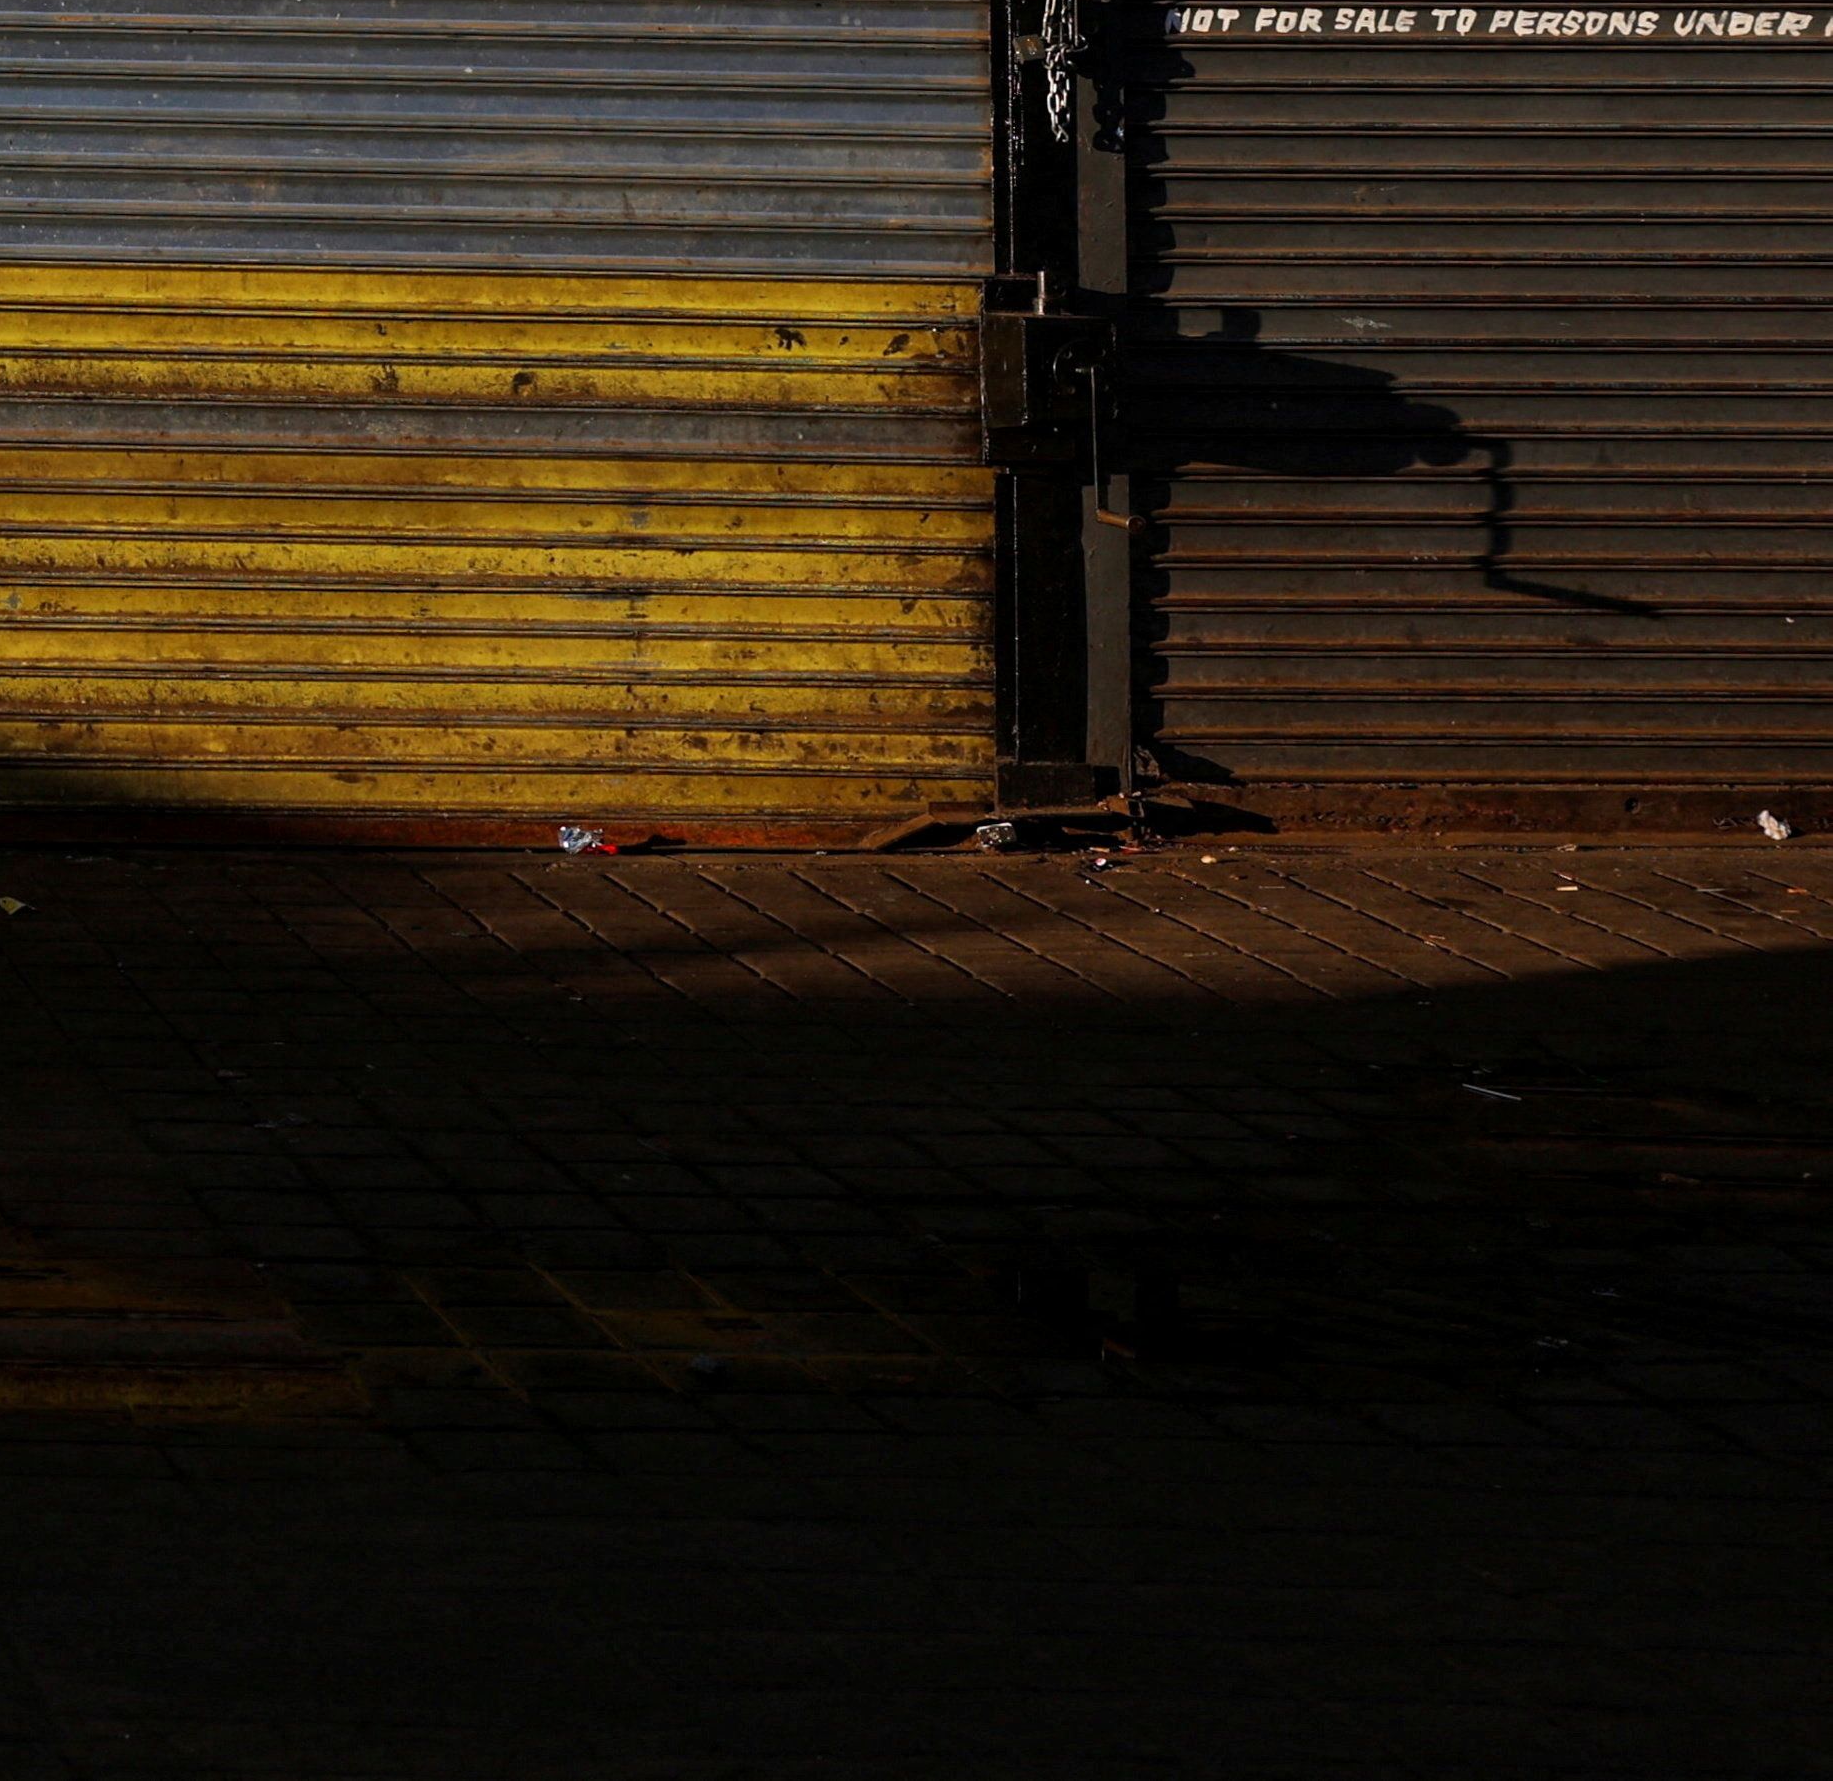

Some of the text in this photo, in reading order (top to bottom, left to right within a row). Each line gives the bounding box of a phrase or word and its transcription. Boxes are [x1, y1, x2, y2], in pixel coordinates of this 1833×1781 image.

[1164, 7, 1241, 34] NOT
[1254, 7, 1322, 34] FOR
[1333, 8, 1417, 35] SALE
[1432, 8, 1474, 37] TO
[1487, 8, 1658, 37] PERSONS
[1673, 9, 1813, 37] UNDER
